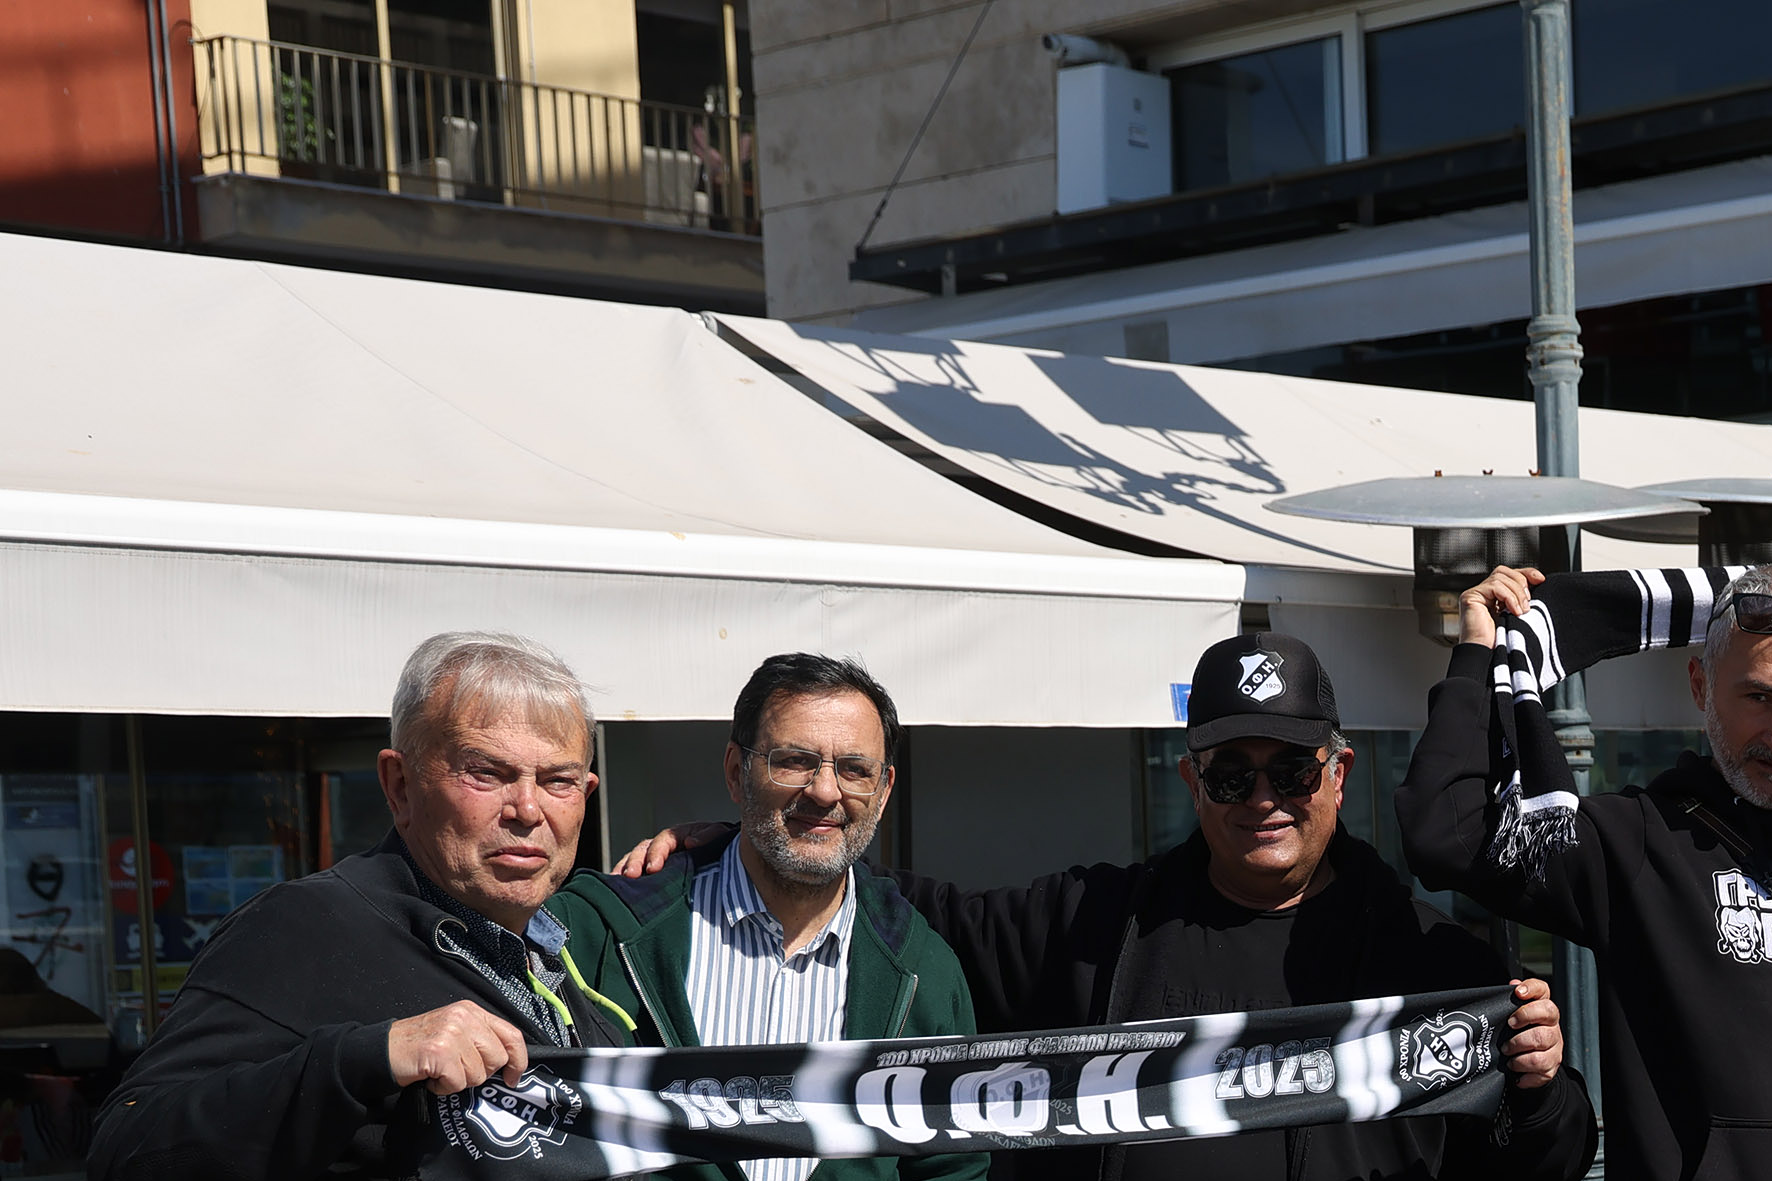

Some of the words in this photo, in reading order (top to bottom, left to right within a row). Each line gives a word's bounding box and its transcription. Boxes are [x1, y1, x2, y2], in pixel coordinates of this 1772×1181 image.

[1241, 660, 1279, 696] Ο.Φ.Η.
[1265, 682, 1281, 690] 1925
[877, 1051, 907, 1067] 100
[908, 1044, 967, 1065] ΧΡΟΝΙΑ
[969, 1038, 1028, 1059] ΟΜΙΛΟΣ
[1028, 1032, 1107, 1056] ΦΙΛΑΘΛΩΝ
[1107, 1031, 1187, 1050] ΗΡΑΚΛΕΙΟΥ
[1214, 1036, 1336, 1100] 2025
[1399, 1068, 1413, 1082] 100
[554, 1078, 574, 1095] 100
[658, 1074, 806, 1131] 1925
[437, 1095, 462, 1148] ΡΑΚΛΕΙΟΥ
[481, 1086, 539, 1126] Ο.Φ.Η.
[1049, 1098, 1073, 1116] 2025
[528, 1134, 544, 1160] 2025
